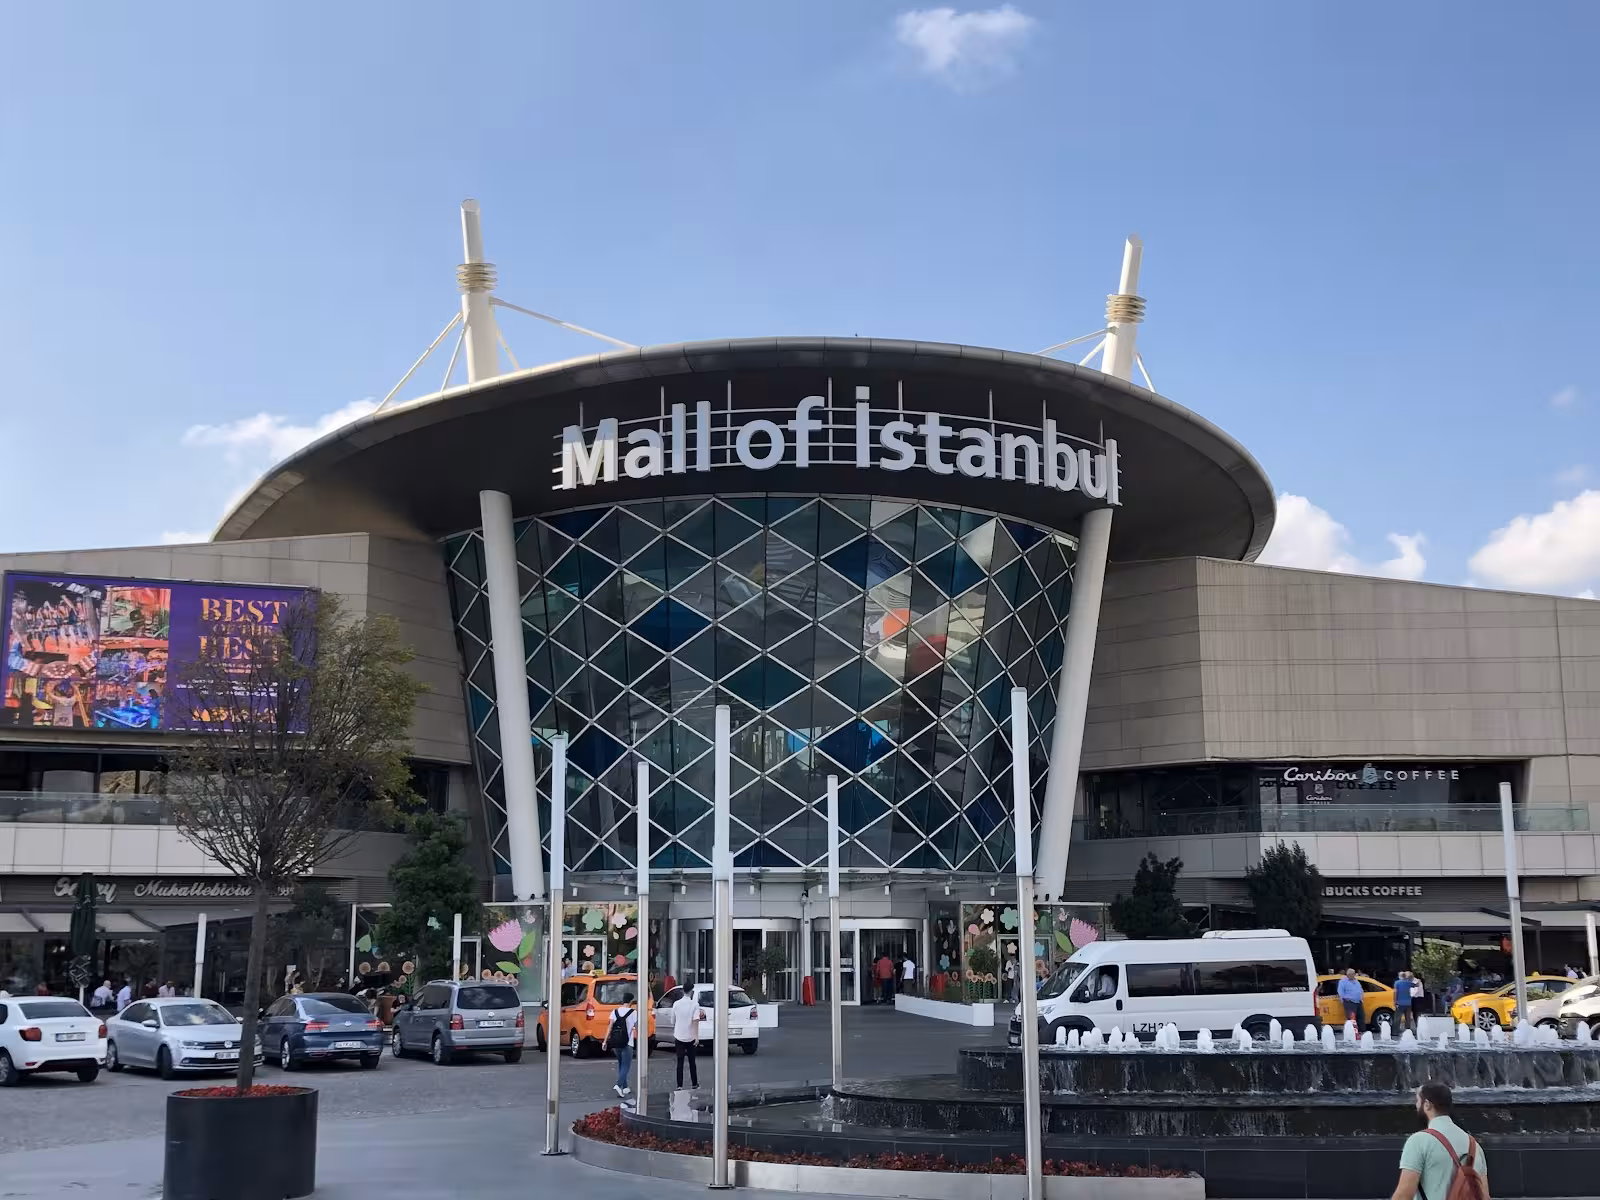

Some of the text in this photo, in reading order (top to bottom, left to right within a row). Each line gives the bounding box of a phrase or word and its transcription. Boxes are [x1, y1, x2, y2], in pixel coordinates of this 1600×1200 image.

[562, 401, 711, 490] Mall
[735, 395, 825, 470] of
[201, 598, 288, 624] BEST
[1283, 767, 1460, 781] Caribou COFFEE
[1372, 886, 1423, 896] COFFEE
